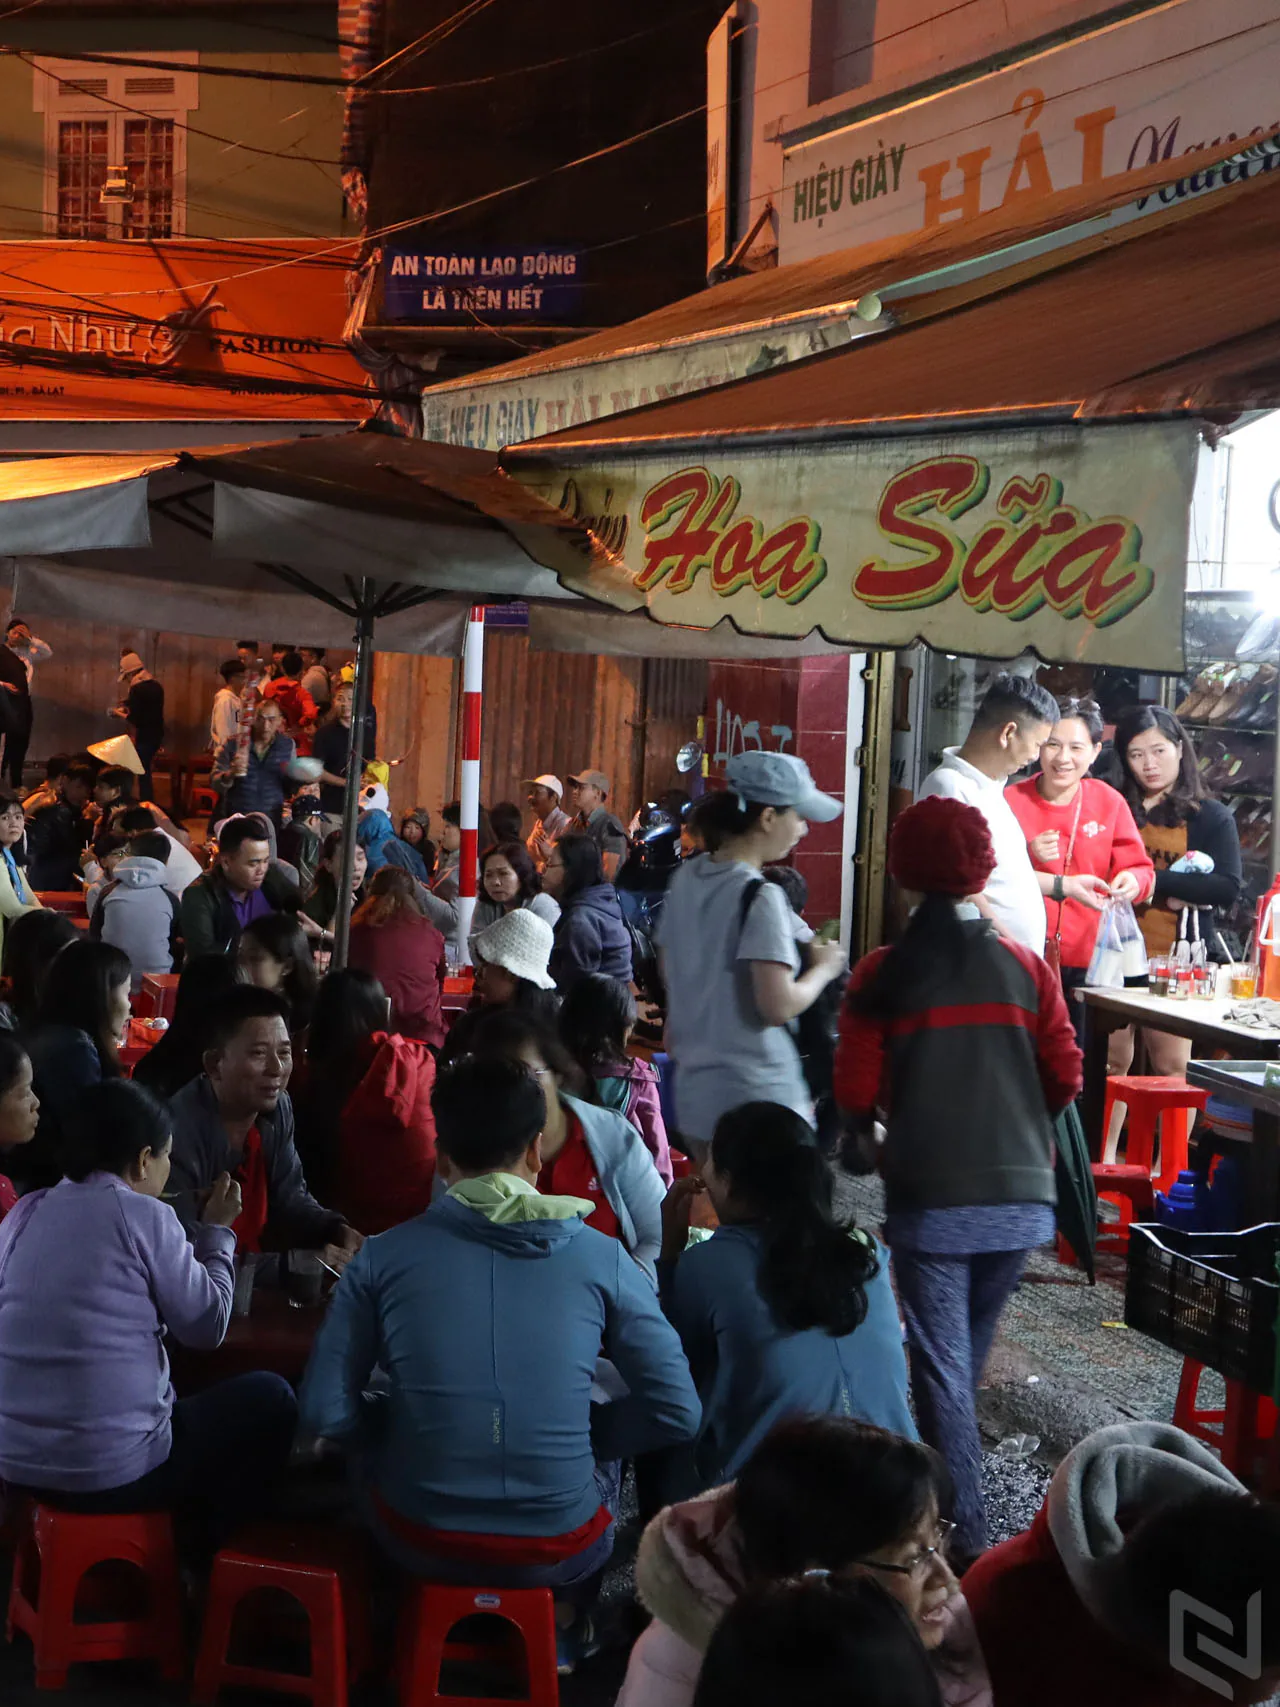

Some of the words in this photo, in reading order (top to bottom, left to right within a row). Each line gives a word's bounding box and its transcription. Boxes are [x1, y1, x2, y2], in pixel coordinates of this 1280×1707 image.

[793, 161, 844, 228] HIỆU
[849, 139, 906, 206] GIÀY
[919, 88, 1116, 229] HẢI
[391, 256, 418, 276] AN
[424, 253, 475, 276] TOÀN
[480, 256, 517, 276] LAO
[522, 252, 576, 279] ĐỘNG
[507, 282, 544, 310] HẾT
[633, 466, 827, 606] Hoa
[852, 454, 1155, 628] Sữa
